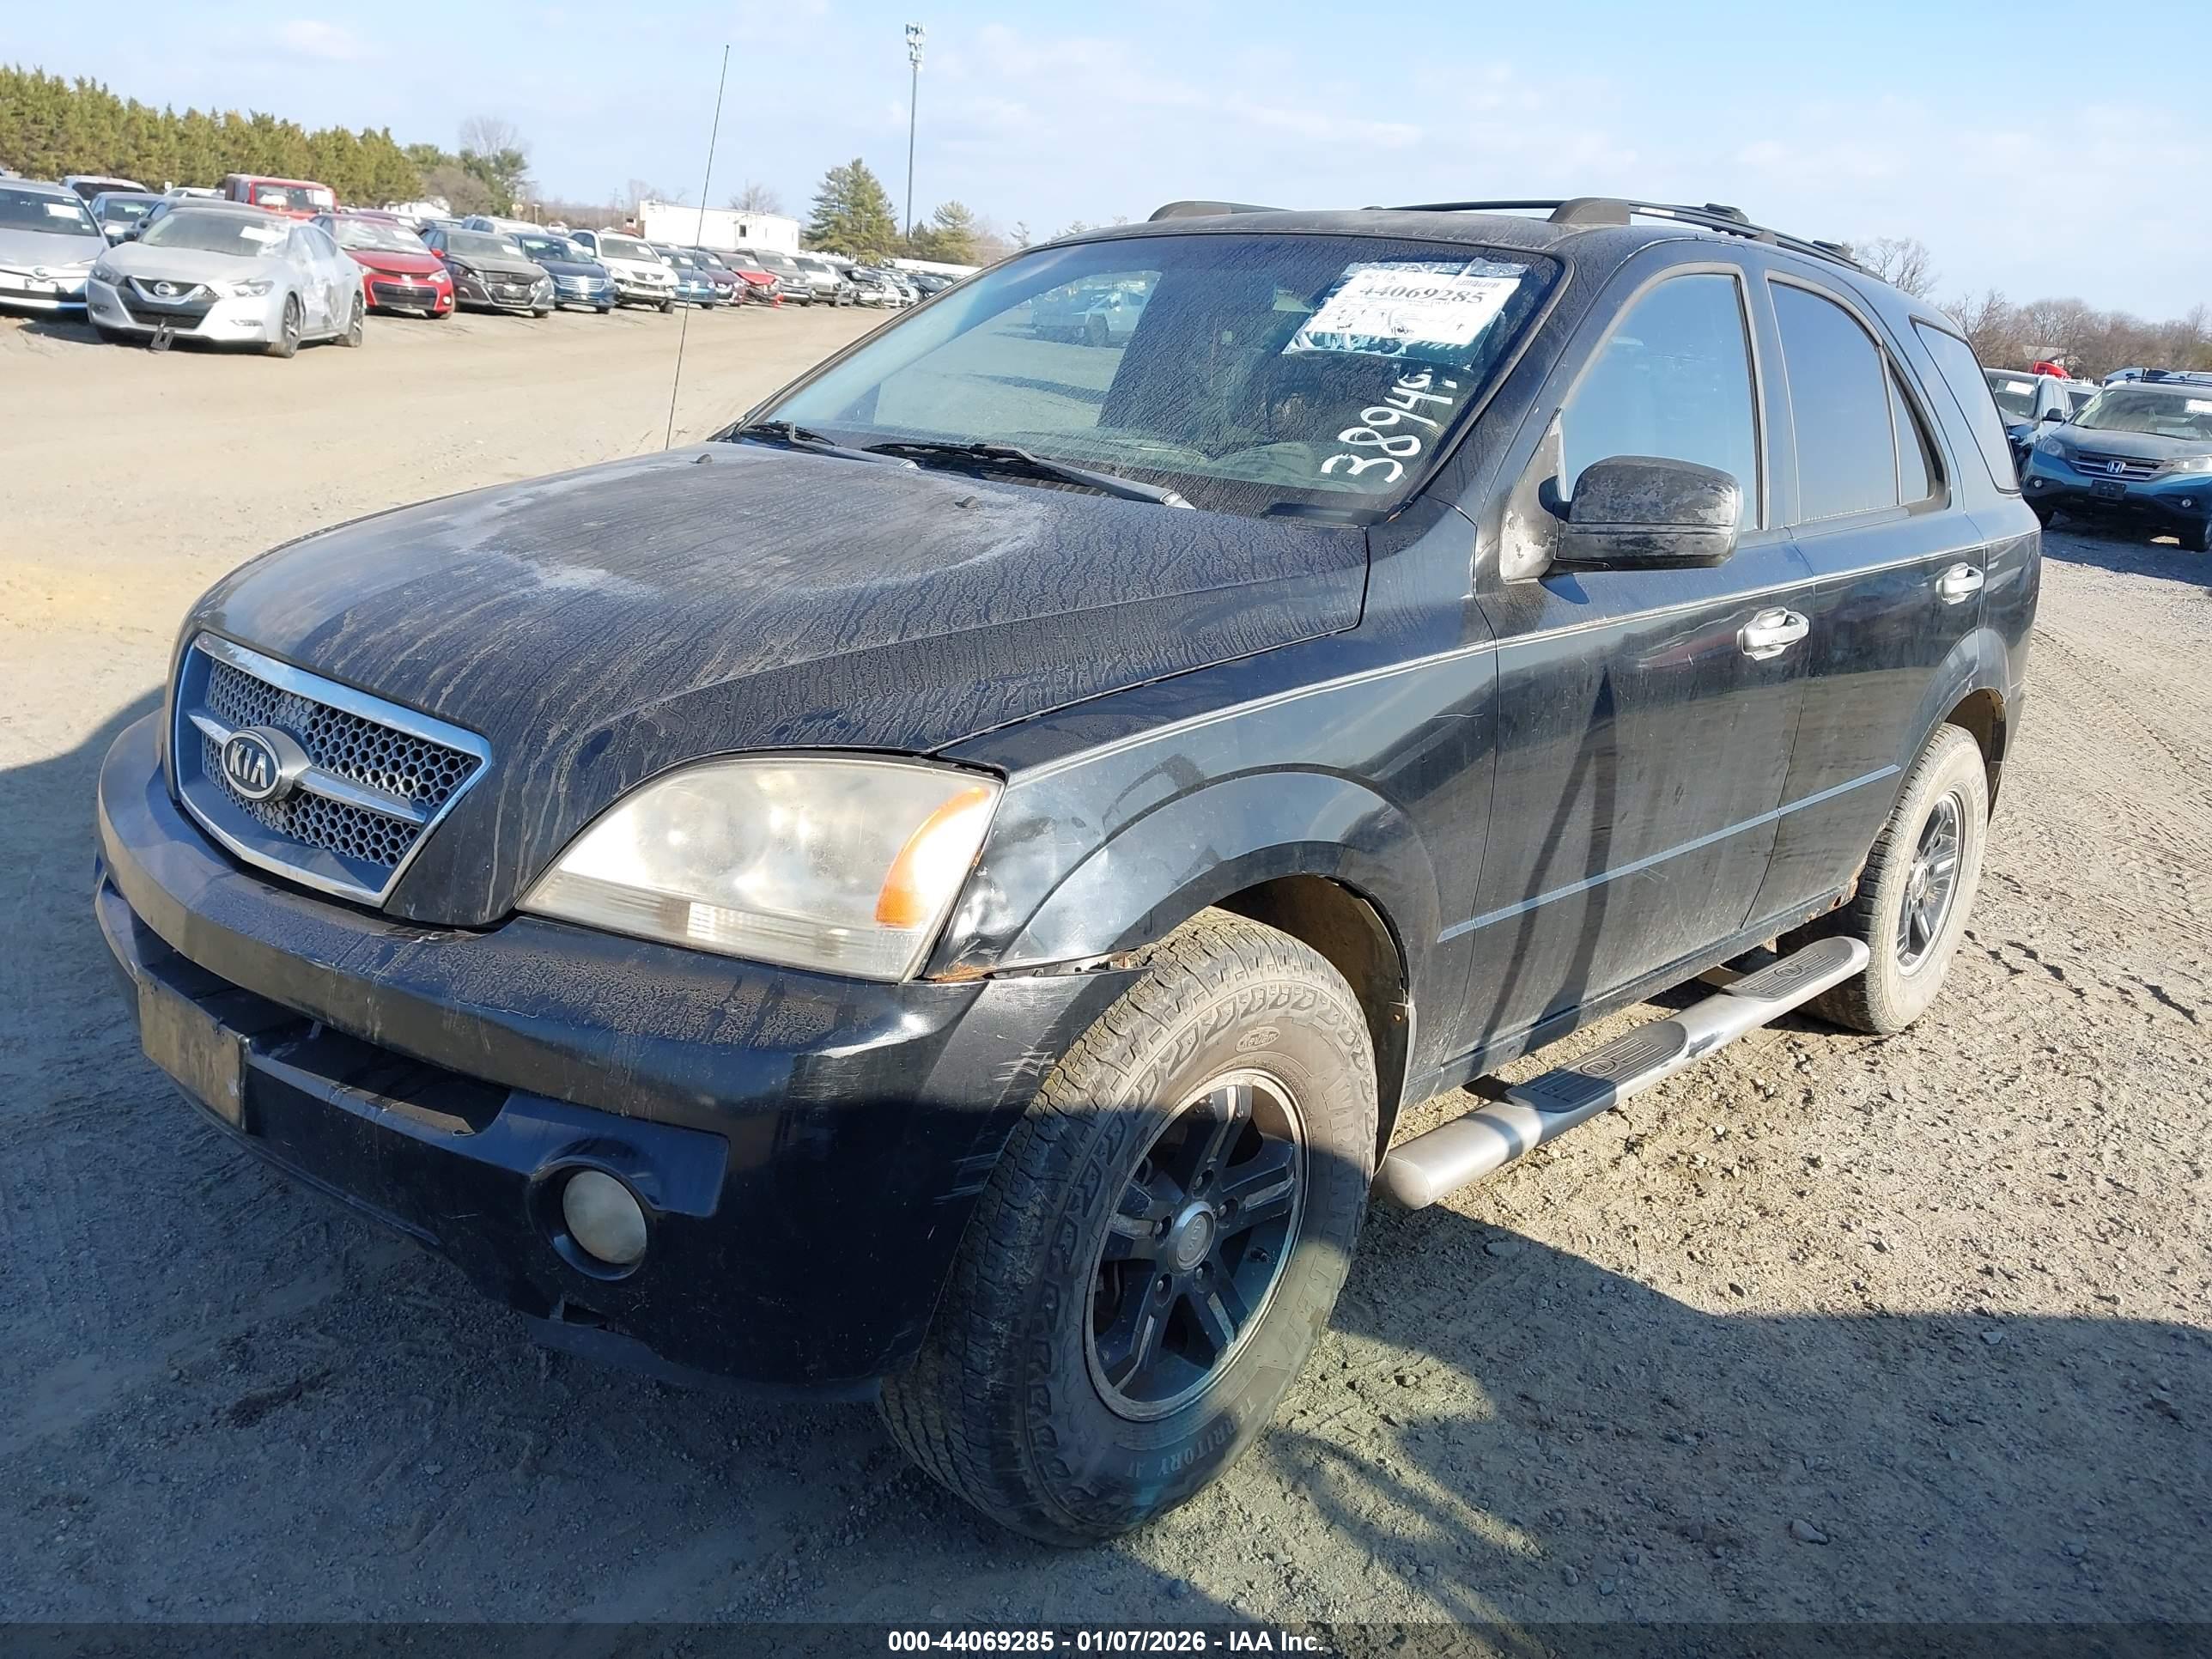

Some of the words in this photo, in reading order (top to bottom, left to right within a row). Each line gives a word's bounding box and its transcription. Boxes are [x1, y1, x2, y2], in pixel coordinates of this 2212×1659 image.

[1359, 284, 1487, 305] 44069285
[229, 740, 268, 788] KIA
[1158, 1395, 1257, 1477] TERRITORY
